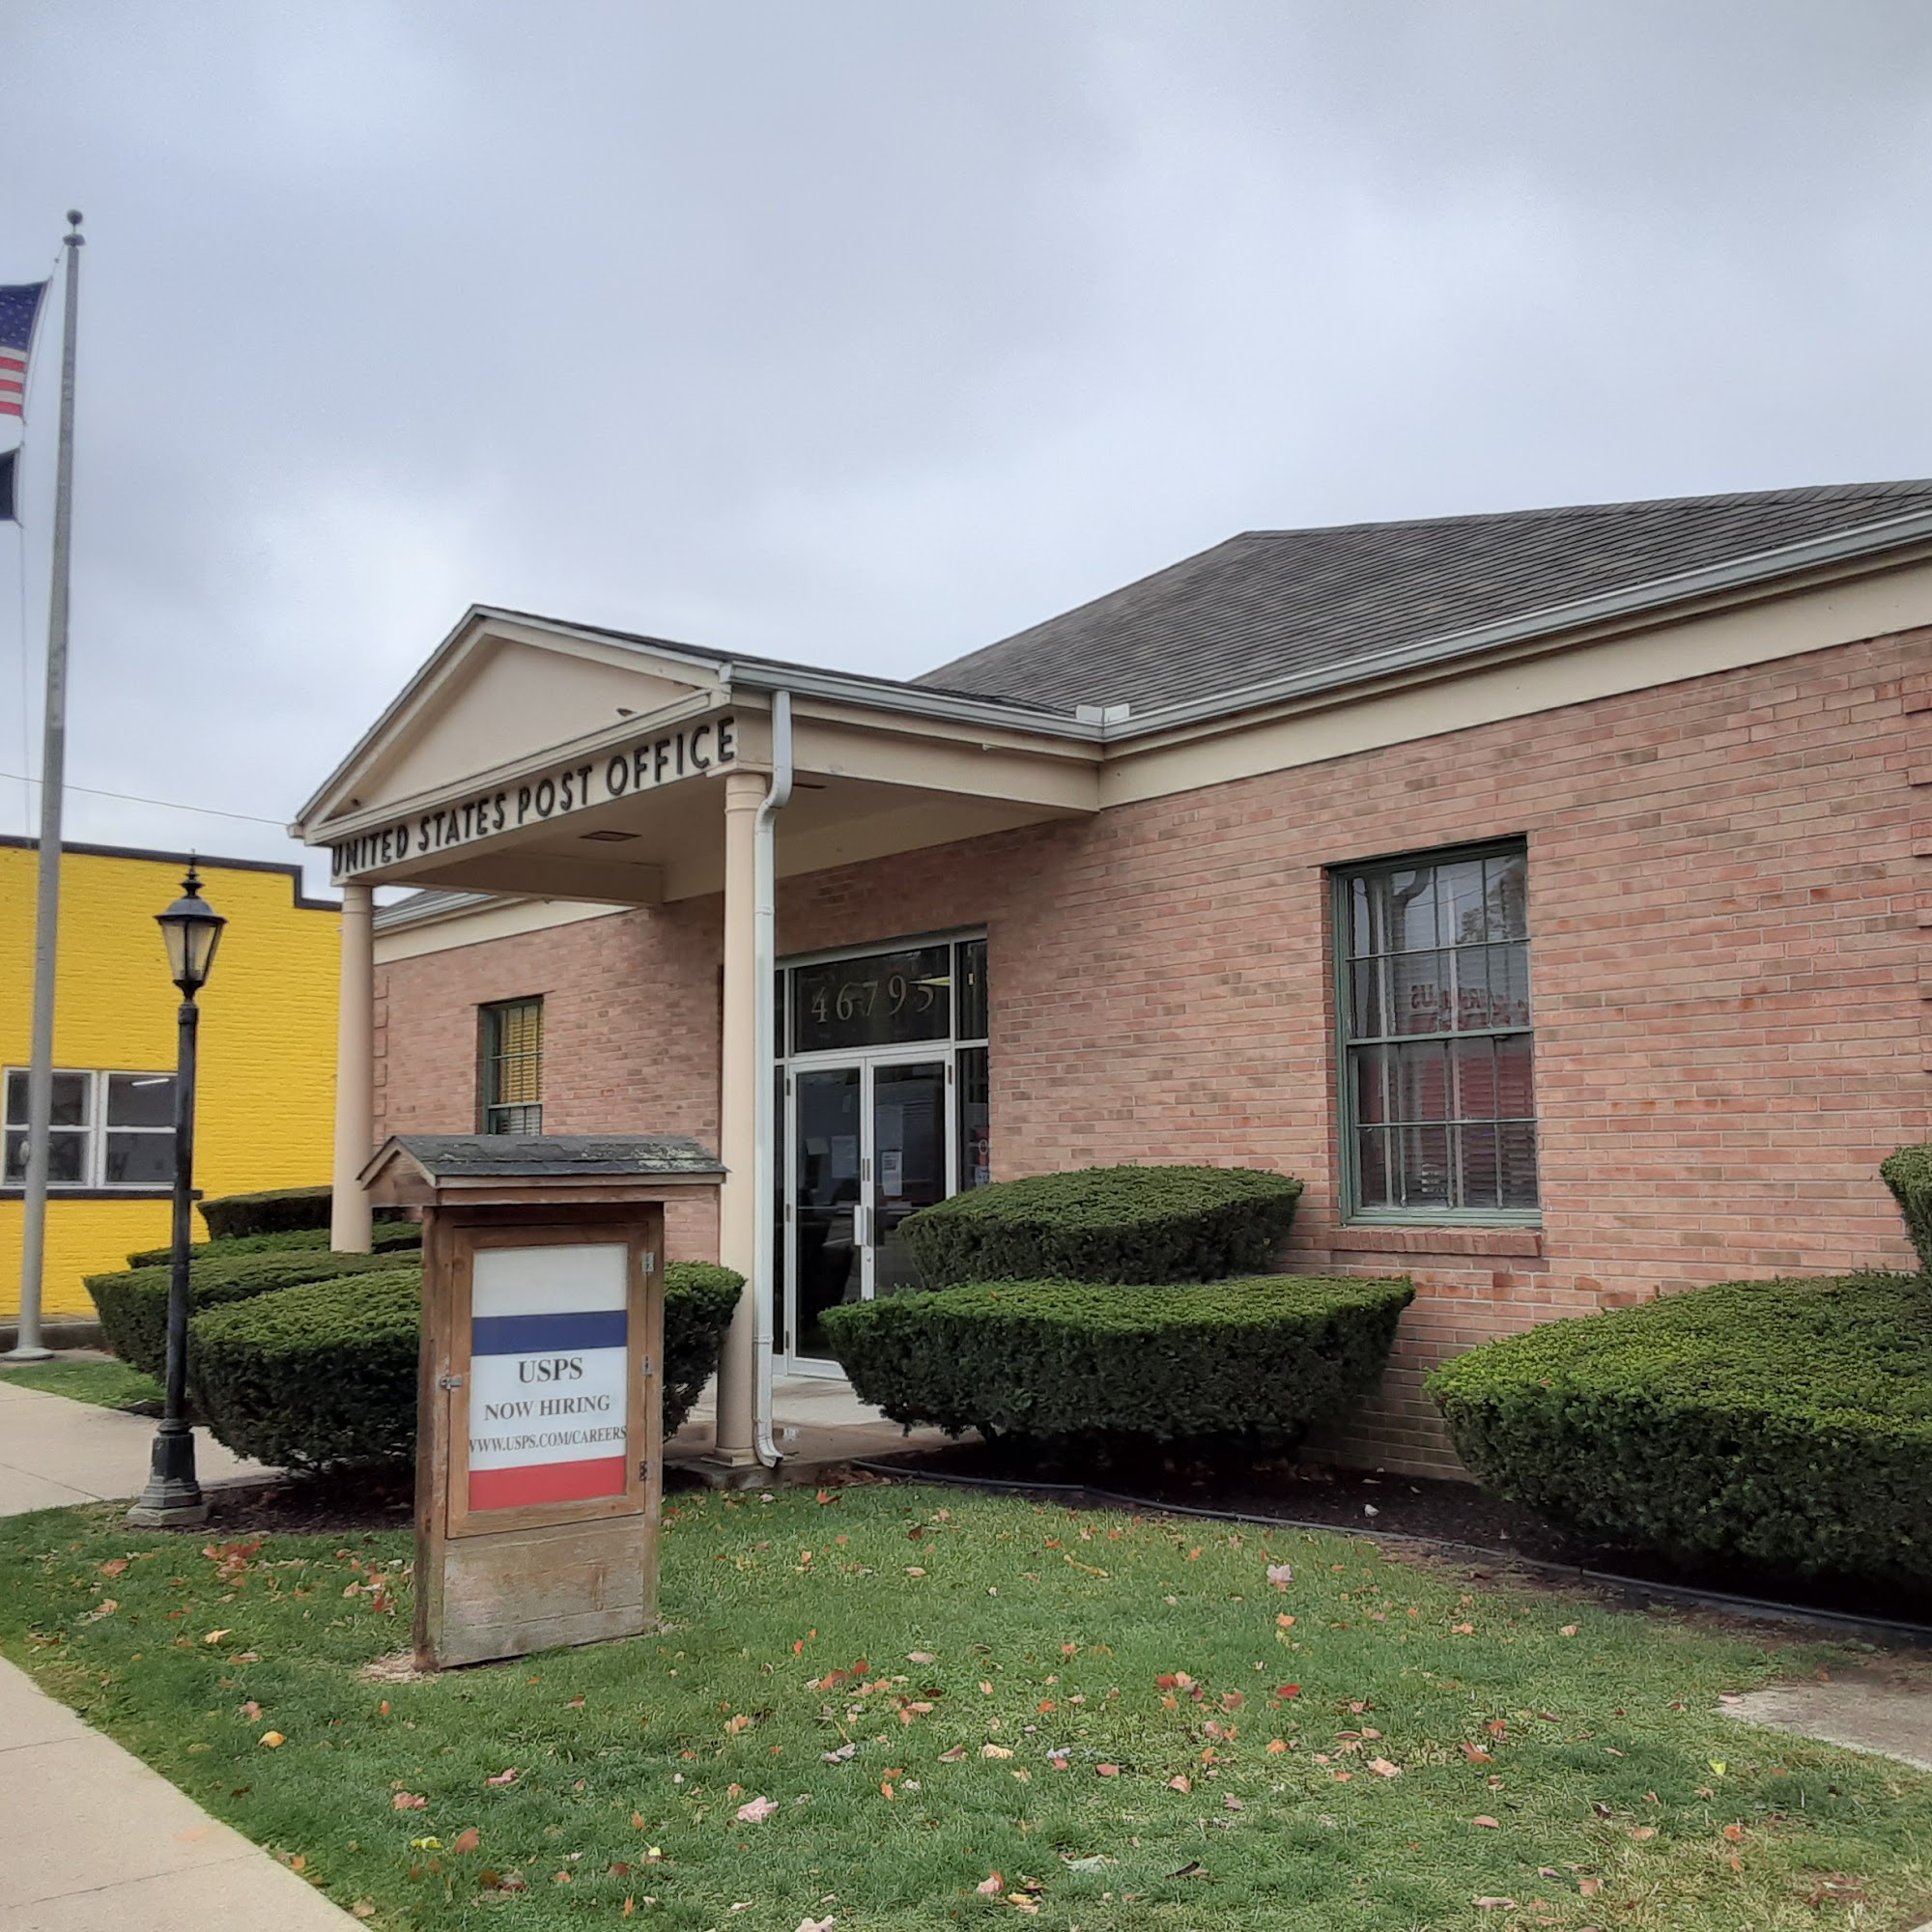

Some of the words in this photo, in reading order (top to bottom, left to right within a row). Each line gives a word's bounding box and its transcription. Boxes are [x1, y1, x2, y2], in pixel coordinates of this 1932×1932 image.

[332, 824, 409, 876] UNITED
[418, 792, 506, 851] STATES
[518, 765, 593, 824] POST
[606, 717, 735, 795] OFFICE
[811, 974, 934, 1023] 46795
[518, 1356, 583, 1383] USPS
[484, 1401, 534, 1421] NOW
[539, 1394, 611, 1417] HIRING
